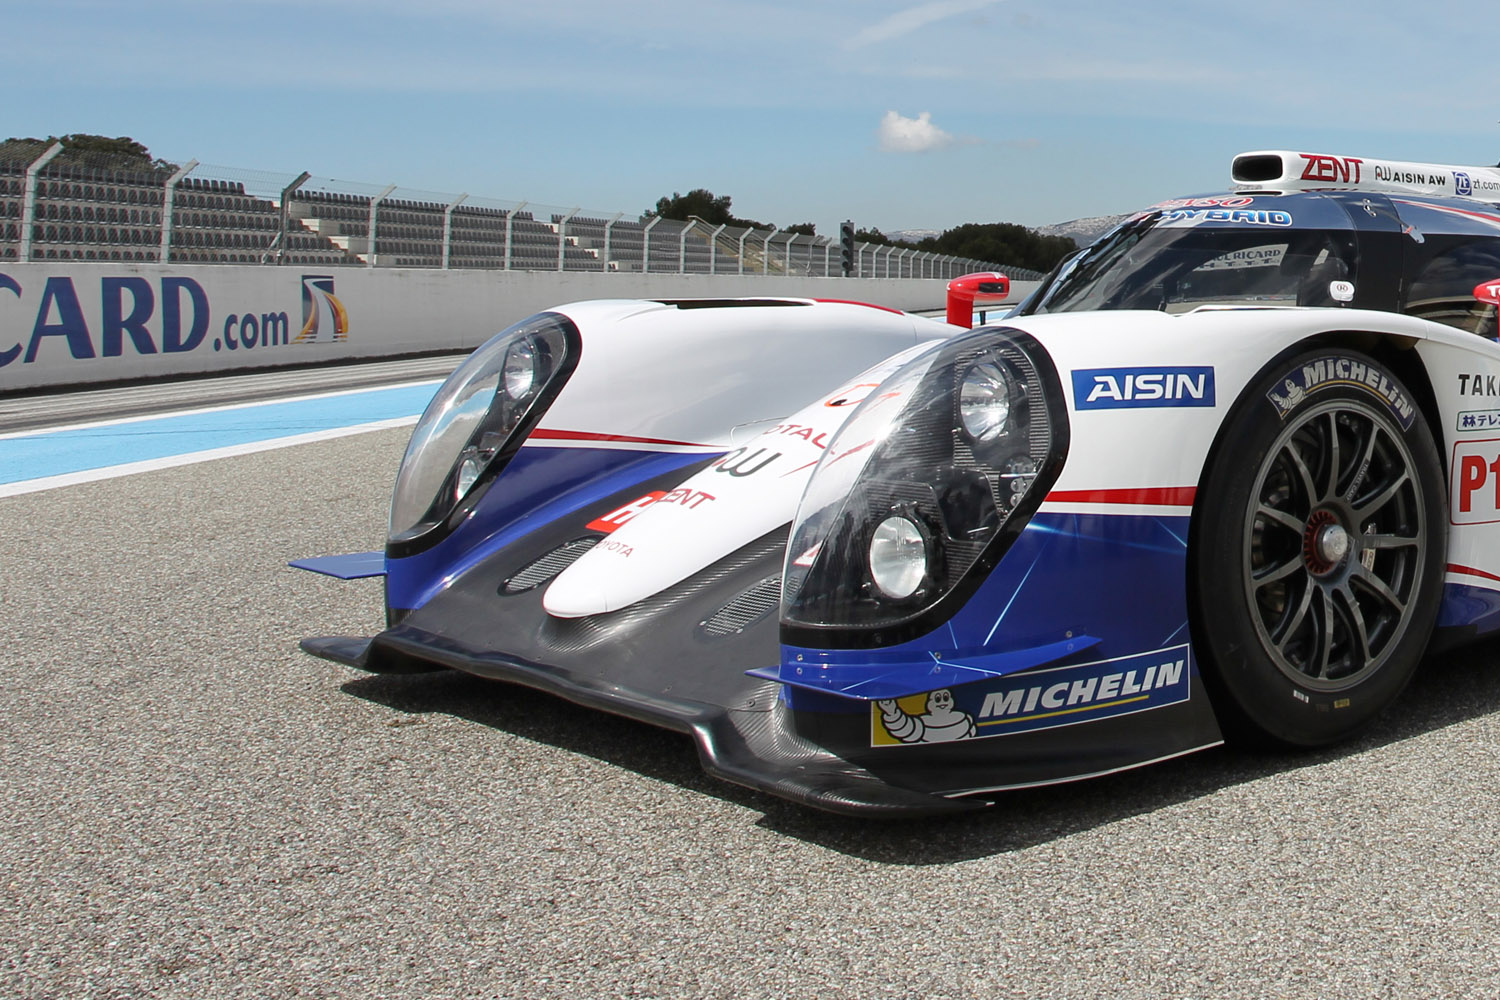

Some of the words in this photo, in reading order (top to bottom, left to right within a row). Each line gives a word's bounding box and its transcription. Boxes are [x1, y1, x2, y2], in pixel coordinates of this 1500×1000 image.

[1299, 153, 1364, 184] ZENT
[1393, 172, 1425, 185] AISIN
[1428, 173, 1446, 187] AW
[1155, 209, 1293, 226] HYBRID
[1233, 249, 1281, 260] RICARD
[1086, 373, 1205, 402] AISIN
[1302, 358, 1413, 422] MICHELIN
[763, 424, 827, 450] OTAL
[661, 487, 717, 510] ENT
[978, 659, 1185, 719] MICHELIN
